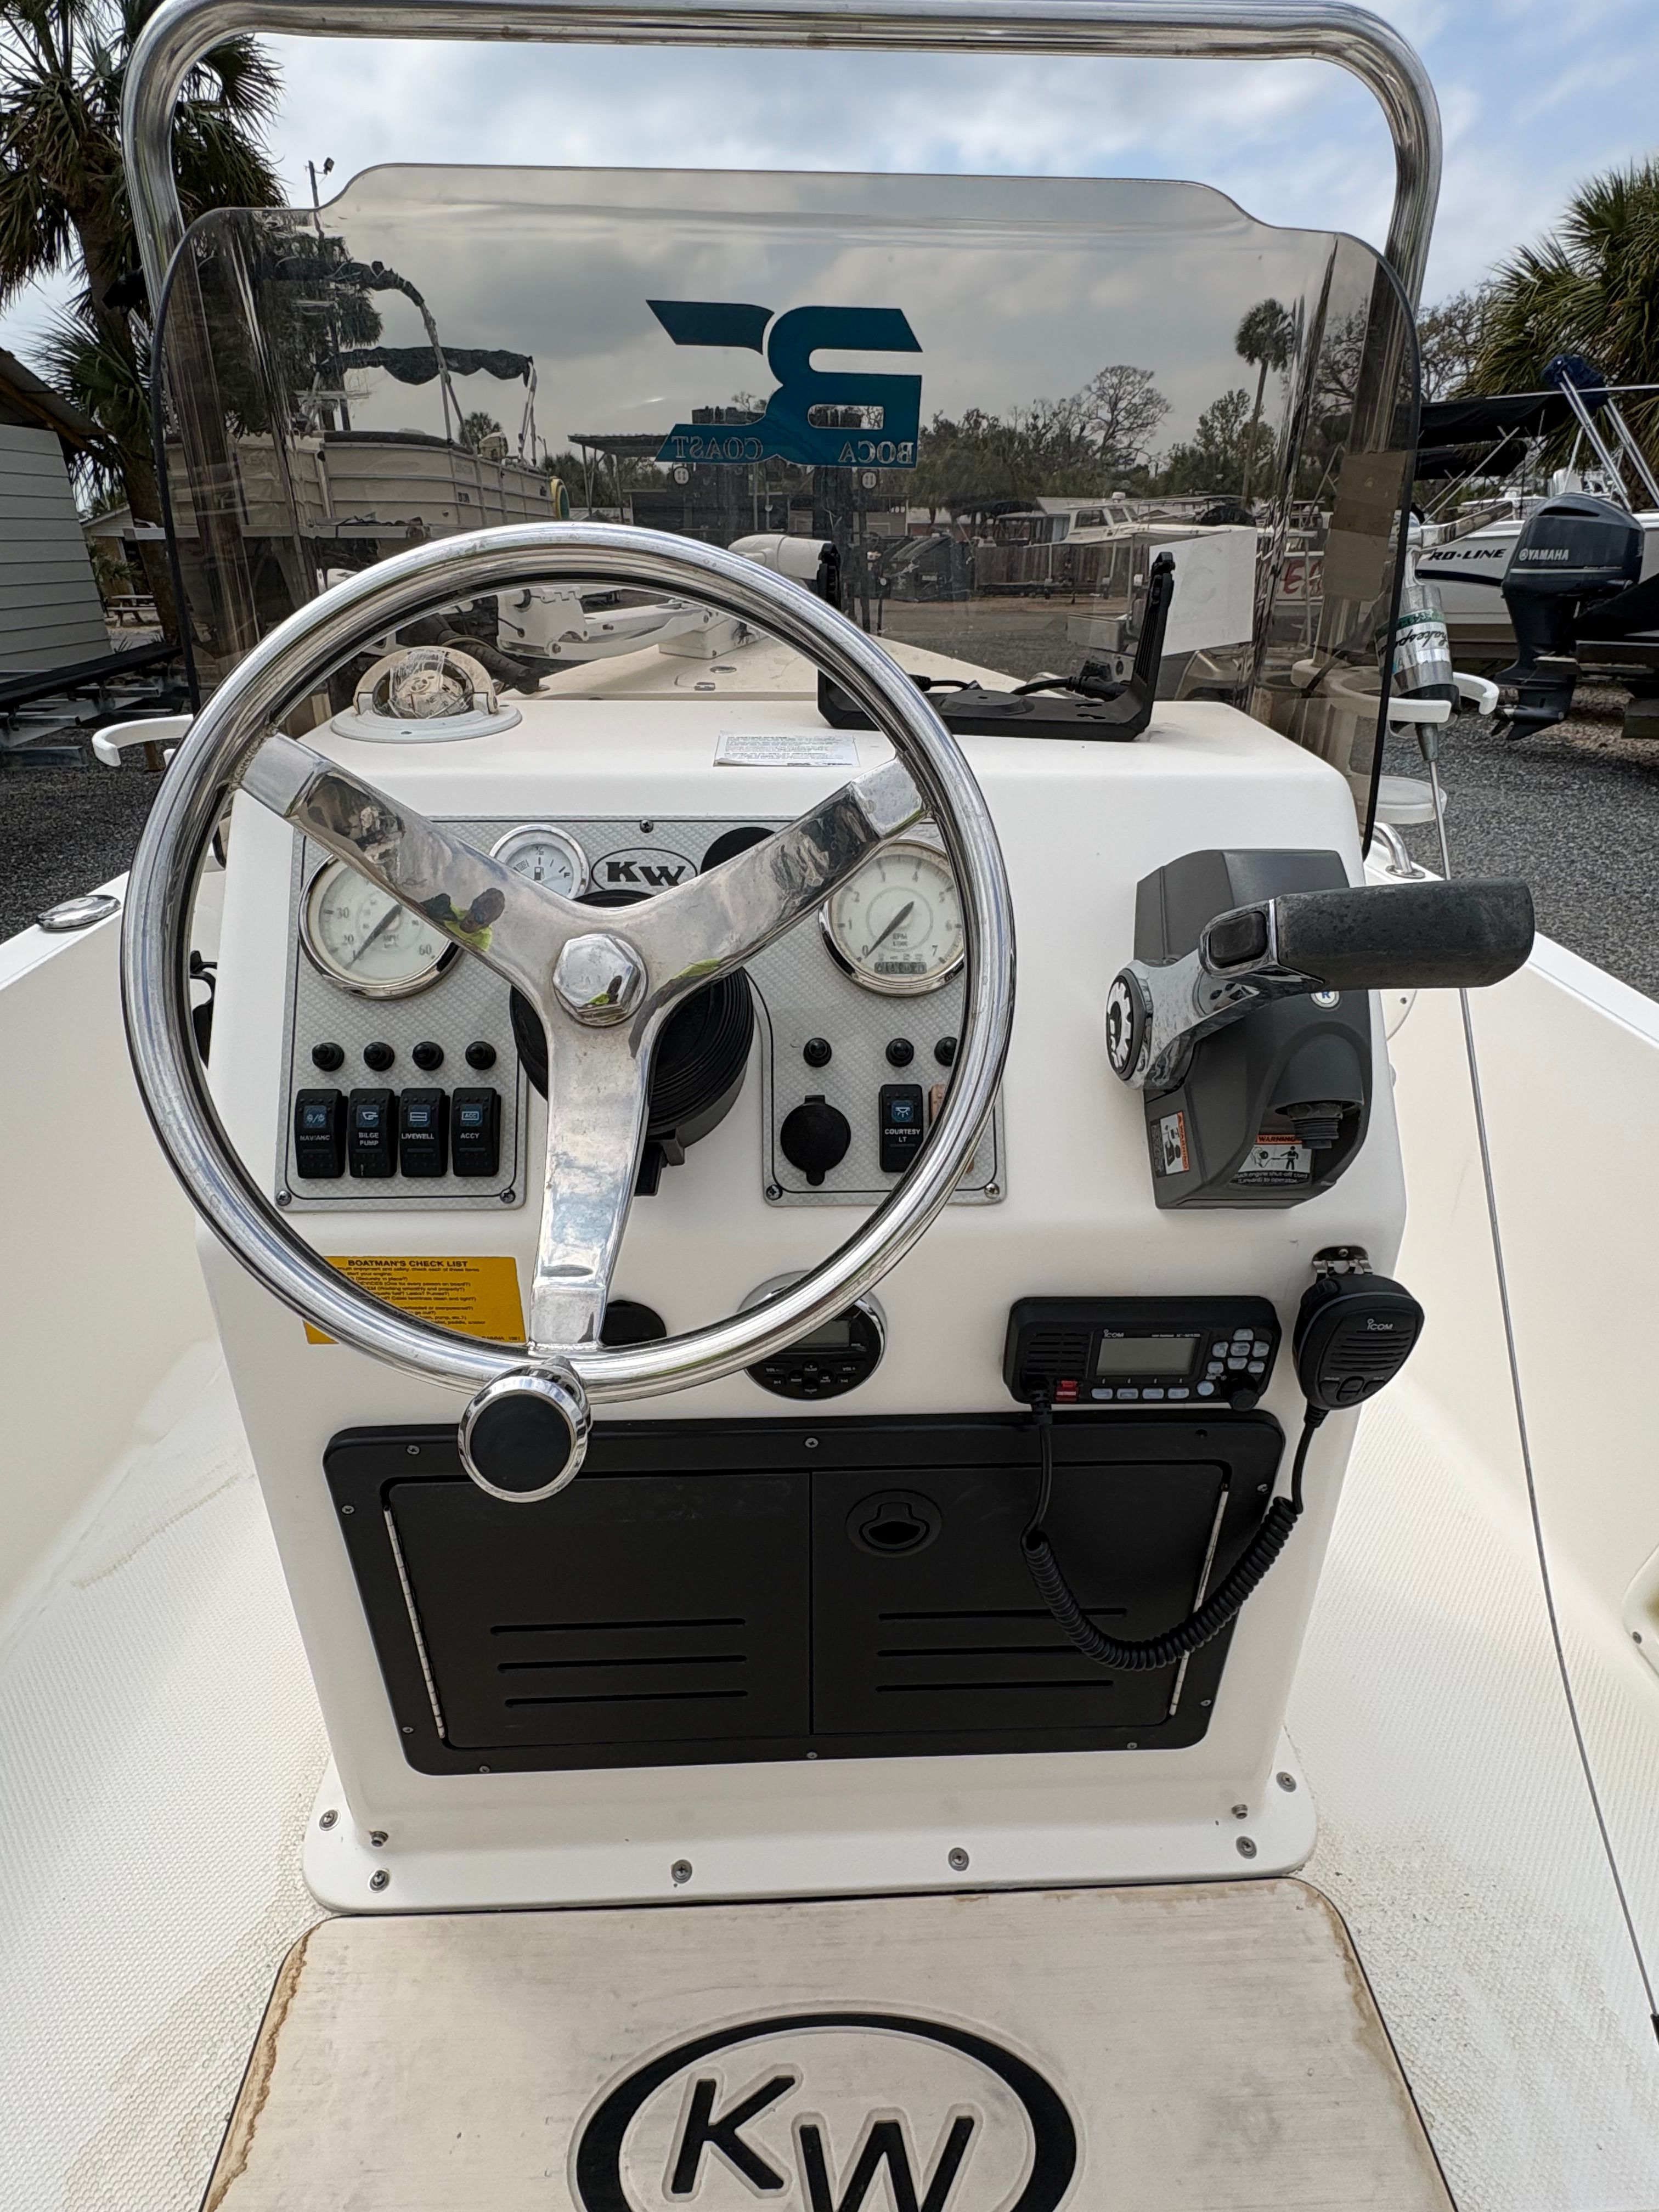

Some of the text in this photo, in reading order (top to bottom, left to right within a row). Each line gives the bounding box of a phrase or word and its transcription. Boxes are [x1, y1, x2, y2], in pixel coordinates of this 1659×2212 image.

[1528, 549, 1569, 561] YAMAHA
[606, 861, 686, 887] KW
[912, 871, 918, 882] 4
[853, 891, 860, 902] 2
[337, 907, 349, 918] 30
[343, 934, 354, 944] 20
[419, 945, 432, 955] 60
[862, 945, 868, 957] 0
[932, 945, 938, 956] 7
[671, 2075, 975, 2212] KW
